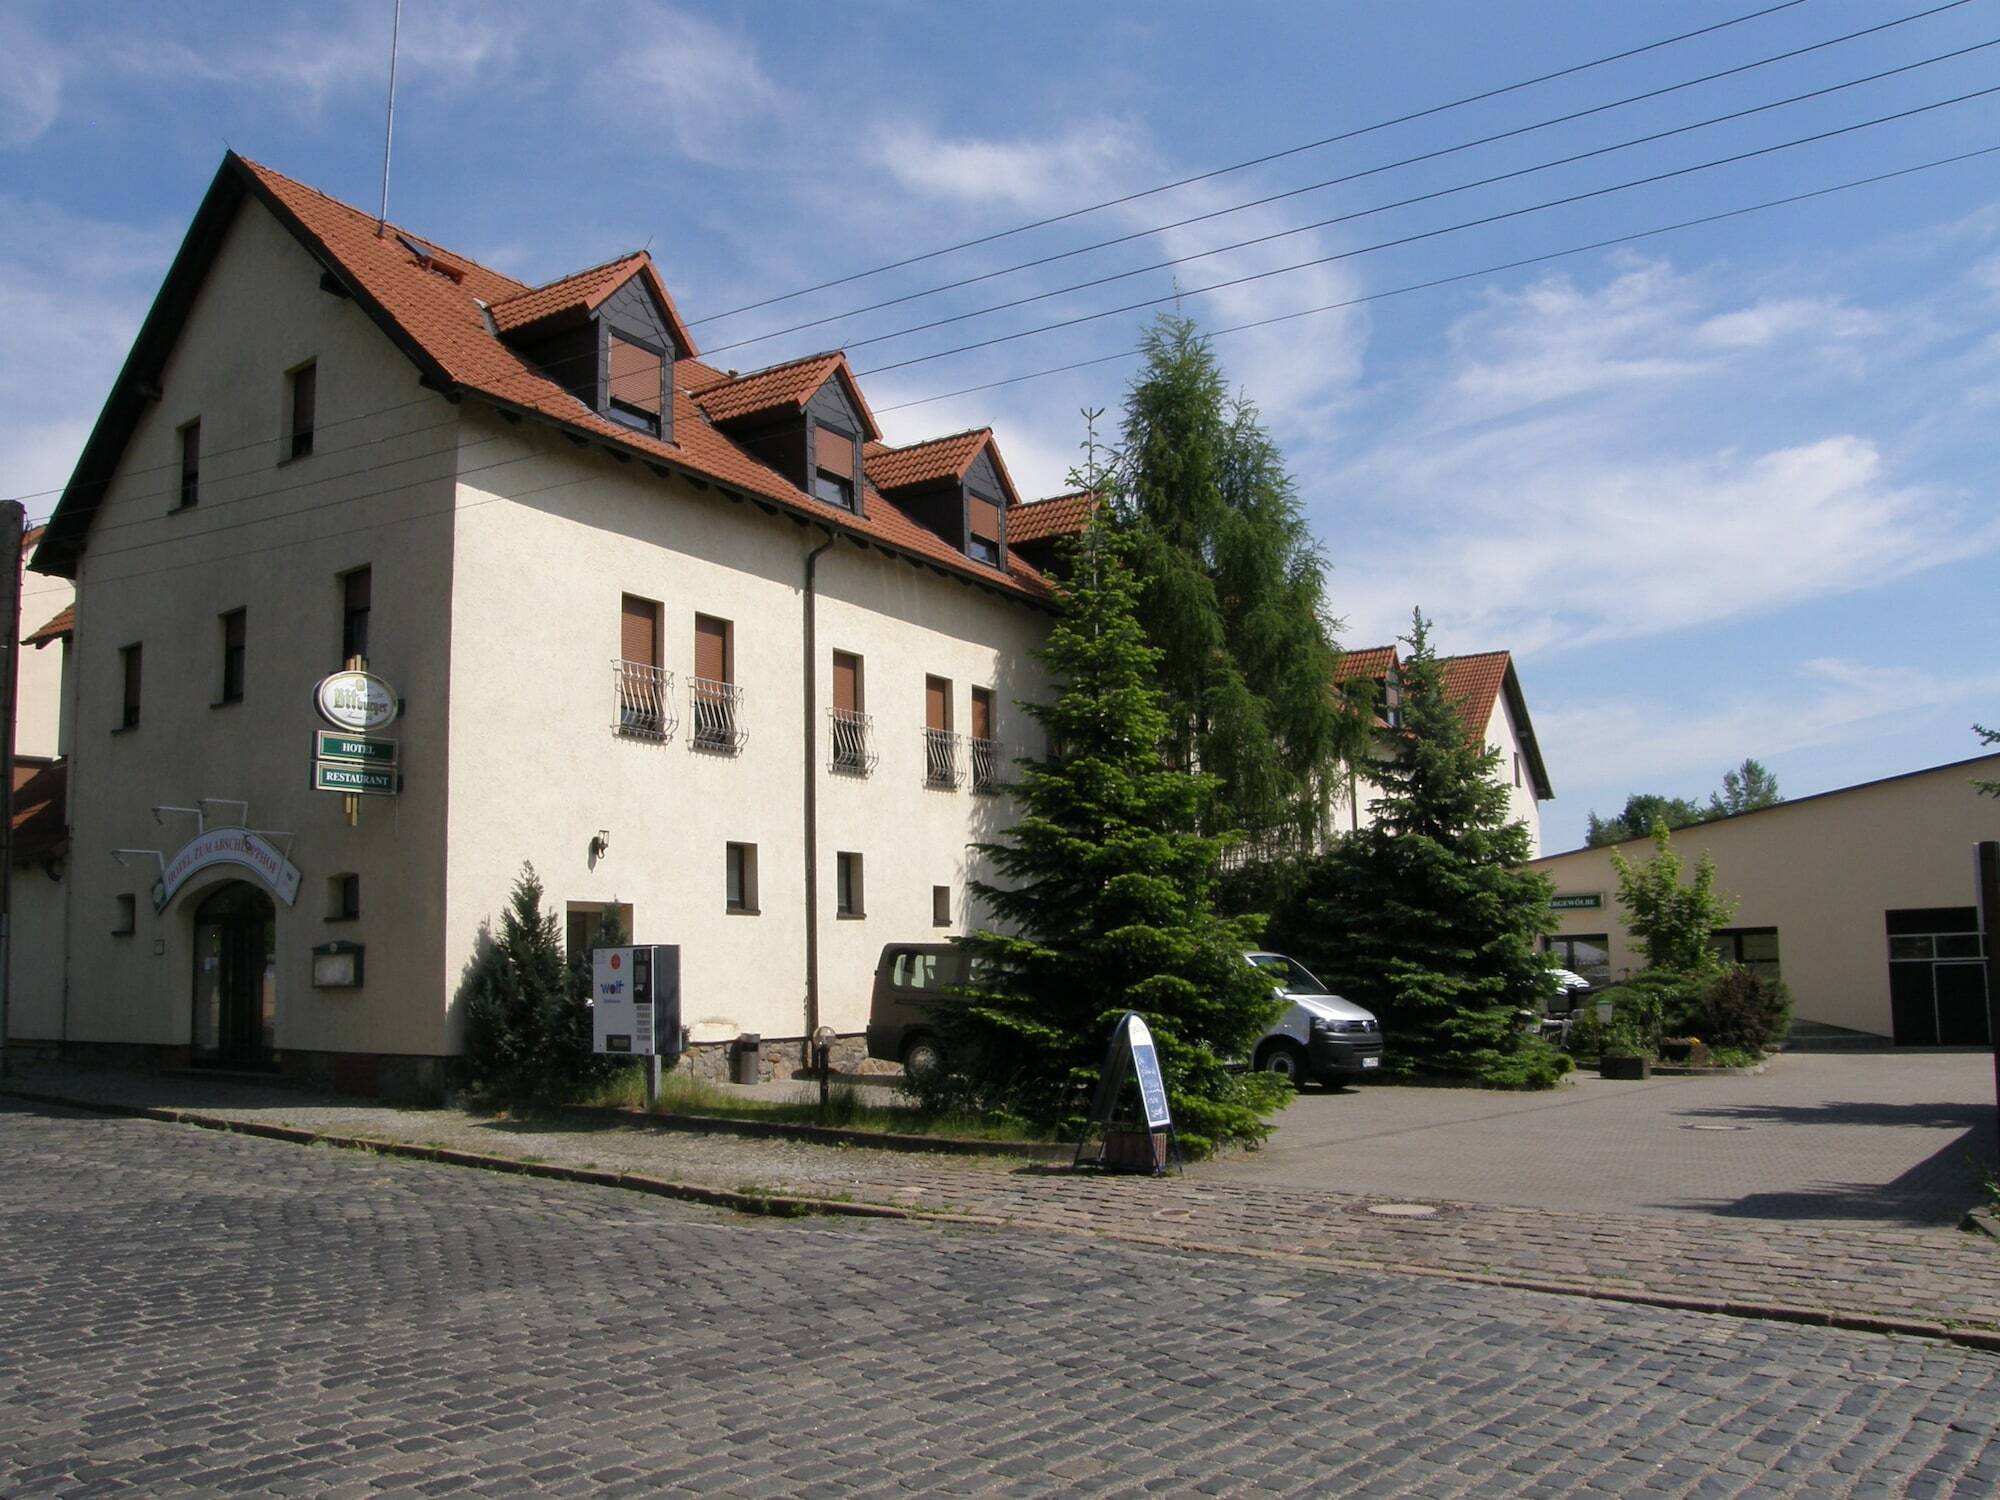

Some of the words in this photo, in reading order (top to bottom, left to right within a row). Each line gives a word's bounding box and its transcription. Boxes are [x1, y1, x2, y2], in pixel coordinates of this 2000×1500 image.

[342, 742, 376, 755] HOTEL
[325, 771, 389, 786] RESTAURANT
[168, 854, 192, 885] HOTEL
